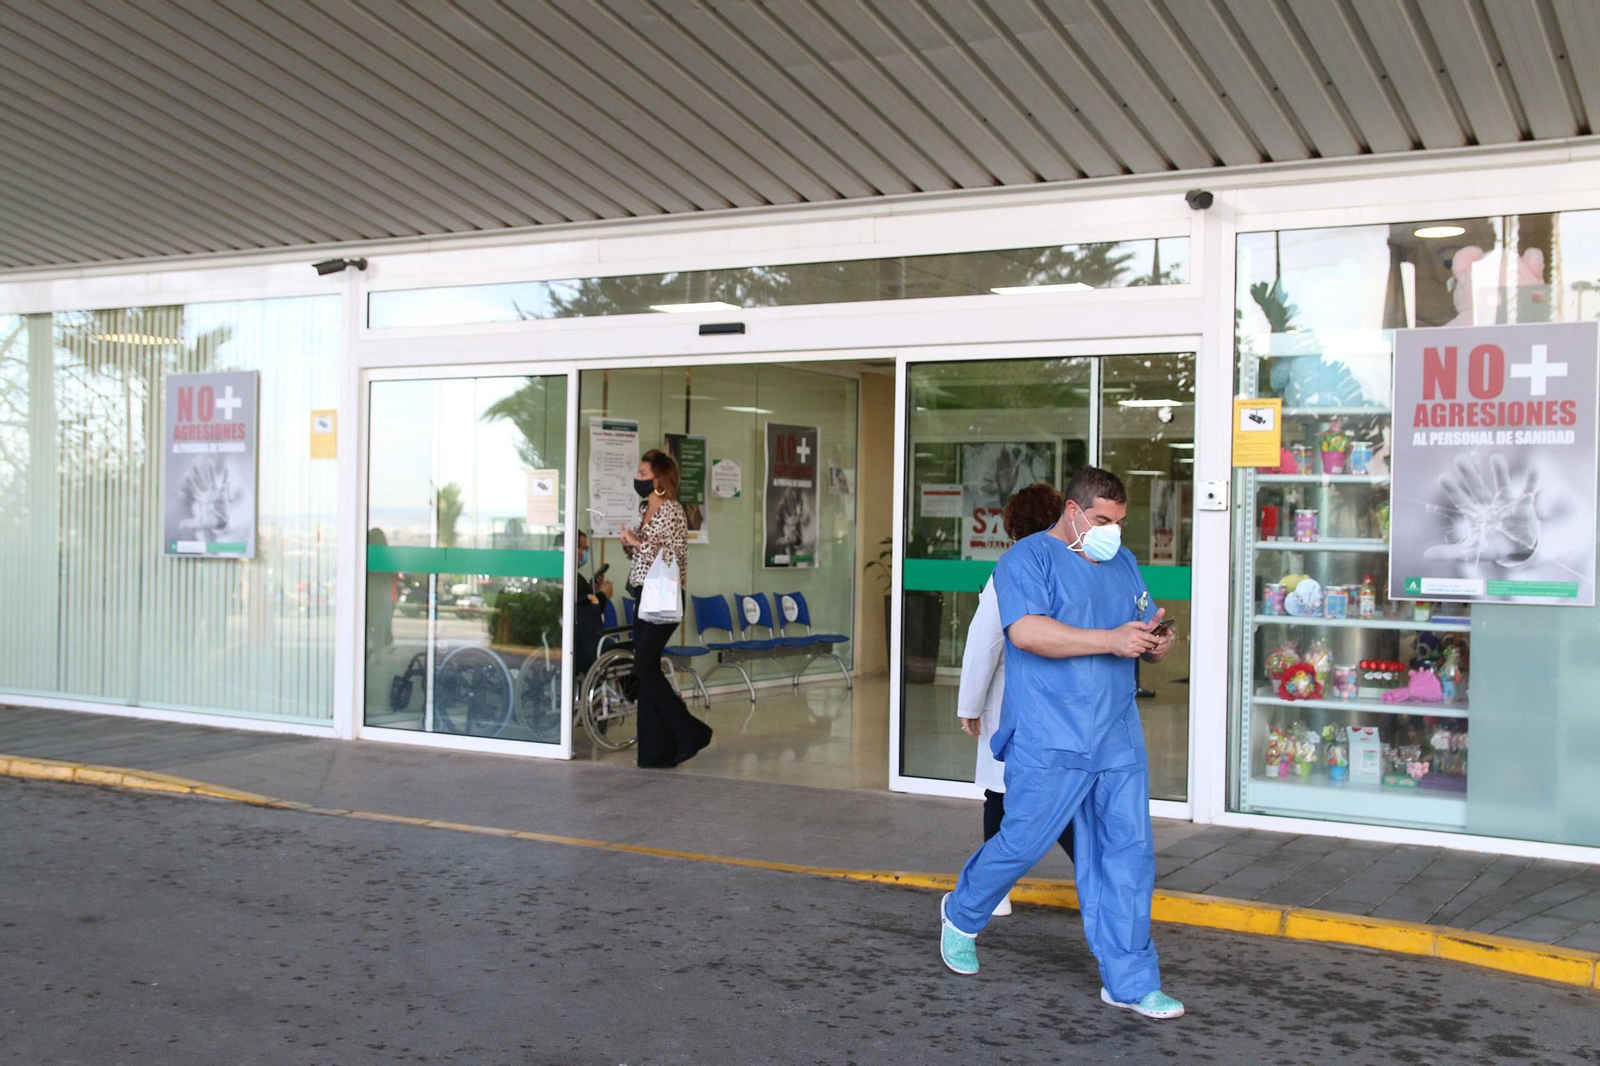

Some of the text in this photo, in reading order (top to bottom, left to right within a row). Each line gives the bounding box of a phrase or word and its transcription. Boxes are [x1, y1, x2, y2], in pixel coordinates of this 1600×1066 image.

[1413, 400, 1577, 428] AGRESIONES
[173, 422, 246, 442] AGRESIONES
[1412, 430, 1575, 446] AL PERSONAL DE SANIDAD
